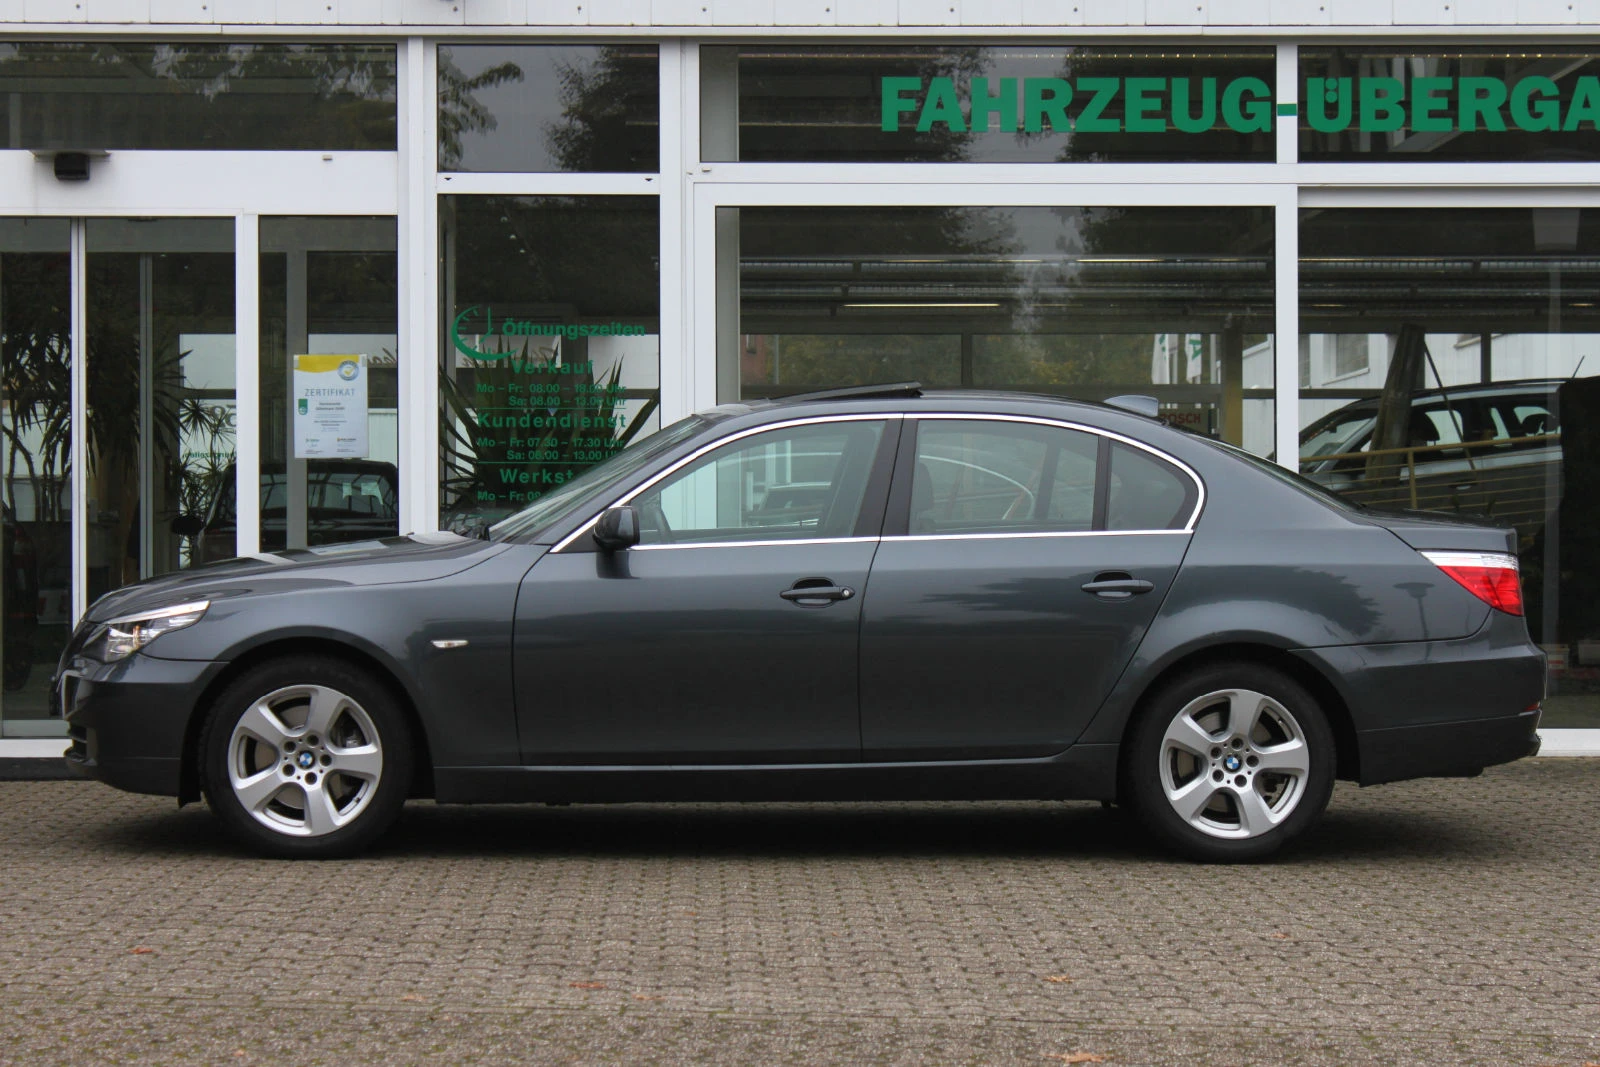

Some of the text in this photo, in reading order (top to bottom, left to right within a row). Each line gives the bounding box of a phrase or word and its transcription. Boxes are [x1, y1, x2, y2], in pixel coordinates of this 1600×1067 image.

[502, 318, 645, 340] Öffnungszeiten
[511, 360, 594, 374] Verkauf
[304, 388, 356, 396] ZERTIFIKAT
[476, 384, 495, 393] Mo
[508, 384, 523, 393] Fr:
[529, 384, 560, 393] 08.00
[606, 384, 626, 393] Uhr
[508, 396, 527, 406] Sa:
[529, 396, 561, 406] 08.00
[477, 413, 626, 428] Kundendienst
[477, 438, 496, 447] Mo
[509, 438, 524, 447] Fr:
[527, 438, 558, 447] 07.30
[573, 438, 600, 447] 17.30
[507, 451, 525, 460] Sa:
[528, 451, 559, 460] 08.00
[573, 451, 602, 460] 13.00
[500, 468, 574, 483] Werkst
[477, 490, 496, 501] Mo
[509, 491, 525, 501] Fr:
